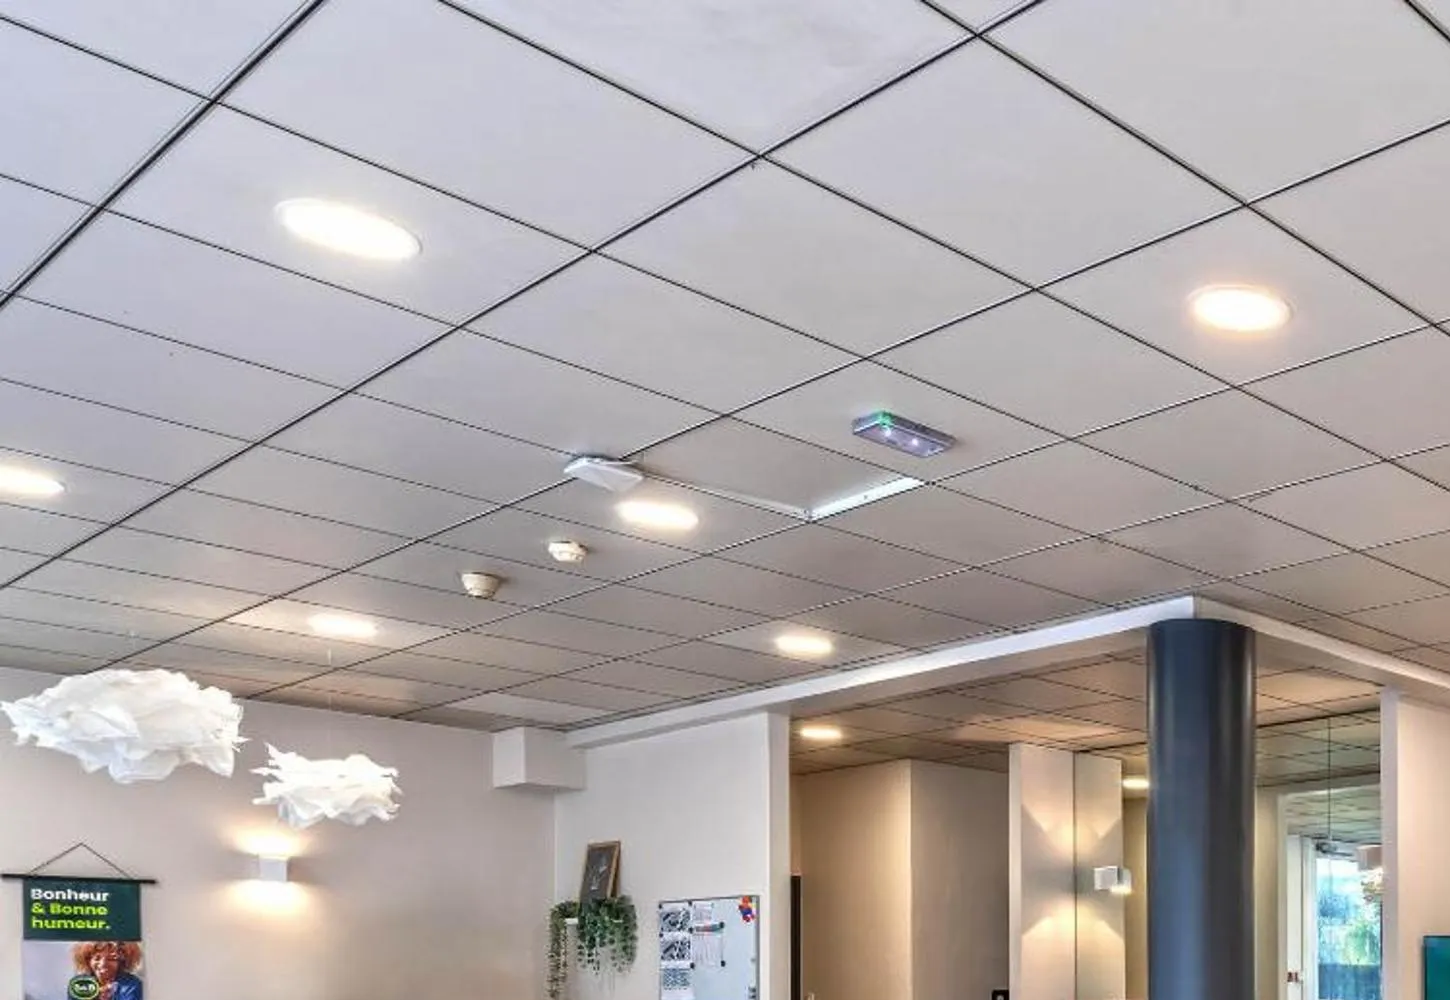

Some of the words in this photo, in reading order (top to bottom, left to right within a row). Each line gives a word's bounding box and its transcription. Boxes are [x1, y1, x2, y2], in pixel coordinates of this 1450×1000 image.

[30, 888, 109, 902] Bonheur
[31, 902, 46, 915] &
[49, 902, 109, 916] Bonne
[31, 916, 111, 930] humeur.
